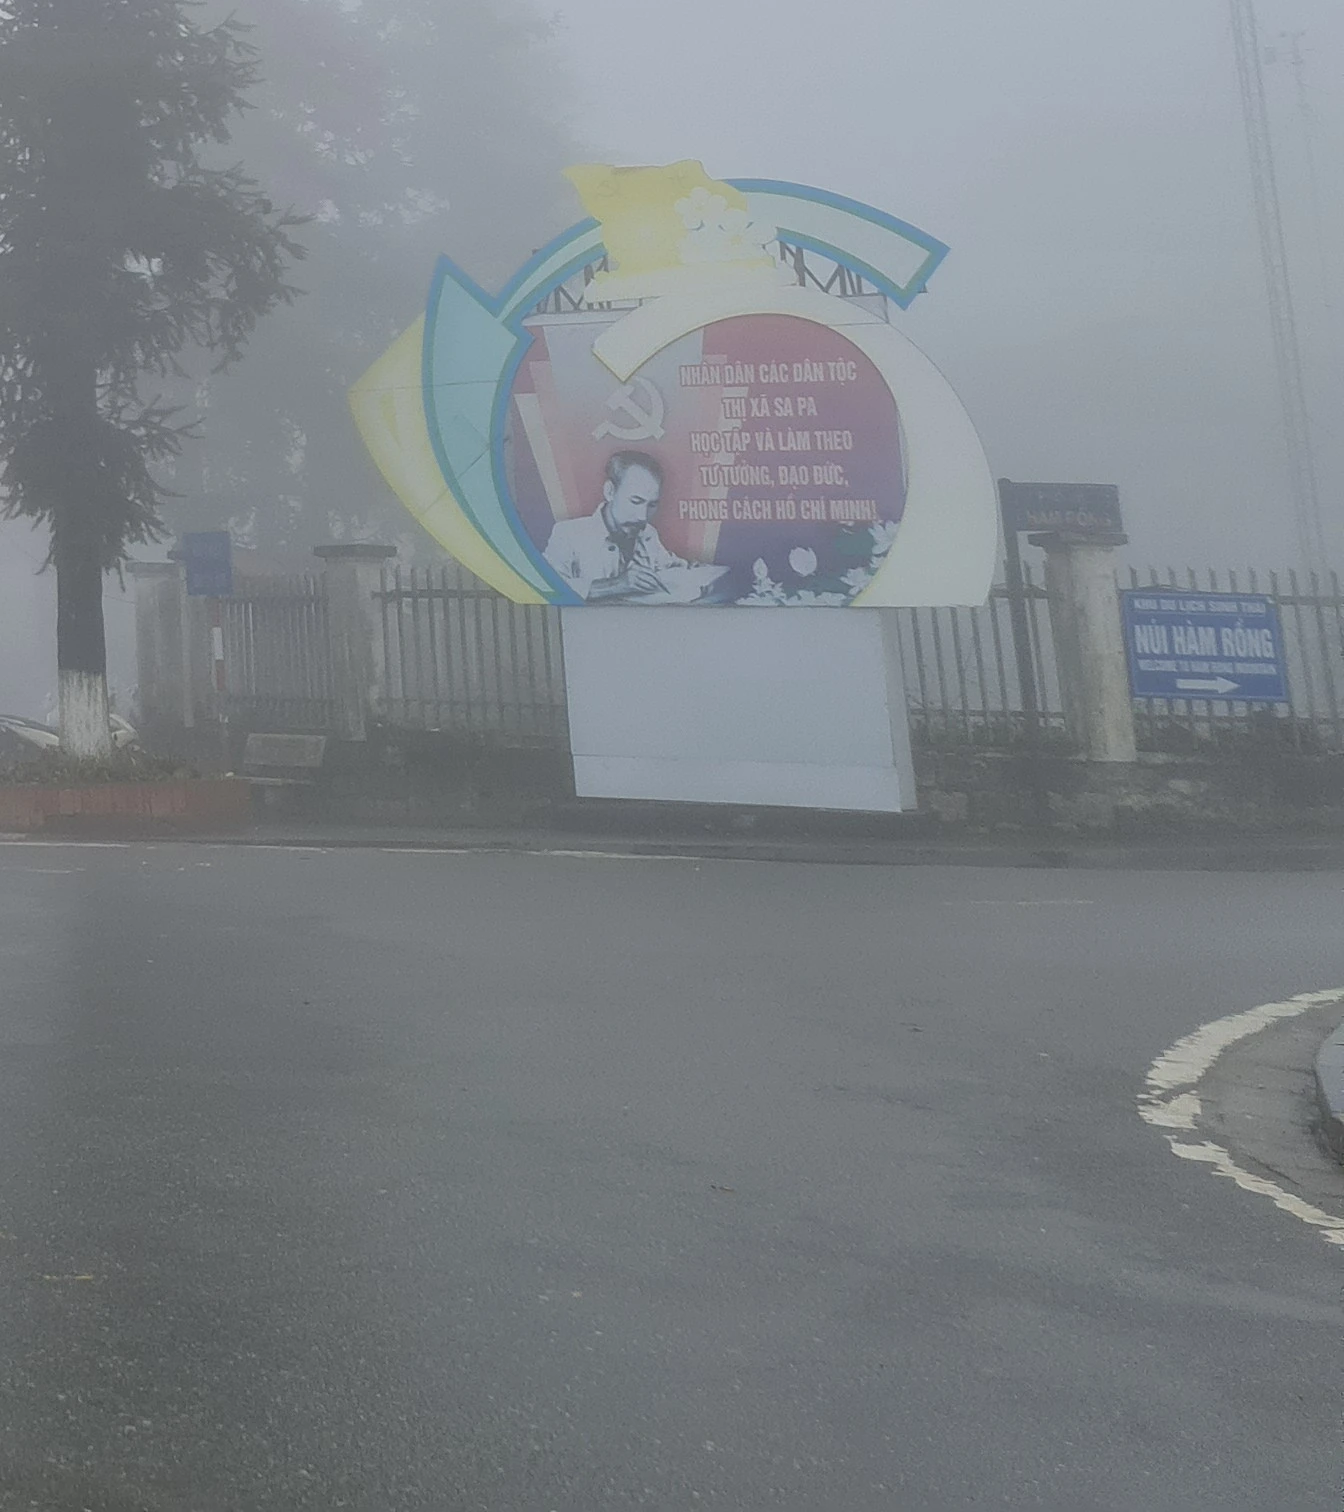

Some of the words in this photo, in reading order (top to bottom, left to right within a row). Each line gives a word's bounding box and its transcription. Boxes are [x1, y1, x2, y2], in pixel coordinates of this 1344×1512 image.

[680, 361, 720, 386] NHÂN
[724, 359, 755, 384] DÂN
[759, 359, 789, 383] CÁC
[793, 358, 824, 382] DÂN
[827, 357, 857, 386] TỘC
[723, 396, 747, 421] THỊ
[750, 394, 770, 417] XÃ
[775, 396, 794, 417] SA
[797, 396, 818, 417] PA
[691, 431, 721, 456] HỌC
[722, 427, 750, 457] TẬP
[755, 428, 776, 451] VÀ
[778, 427, 810, 451] LÀM
[814, 430, 853, 451] THEO
[700, 464, 721, 486] TƯ
[721, 460, 775, 488] TƯỞNG,
[778, 466, 808, 490] ĐẠO
[679, 500, 728, 520] PHONG
[732, 496, 772, 520] CÁCH
[775, 493, 797, 520] HỒ
[800, 495, 825, 520] CHÍ
[830, 500, 877, 521] MINH!
[1133, 618, 1169, 655] NÚI
[1171, 620, 1218, 656] HÀM
[1220, 617, 1276, 659] RỒNG
